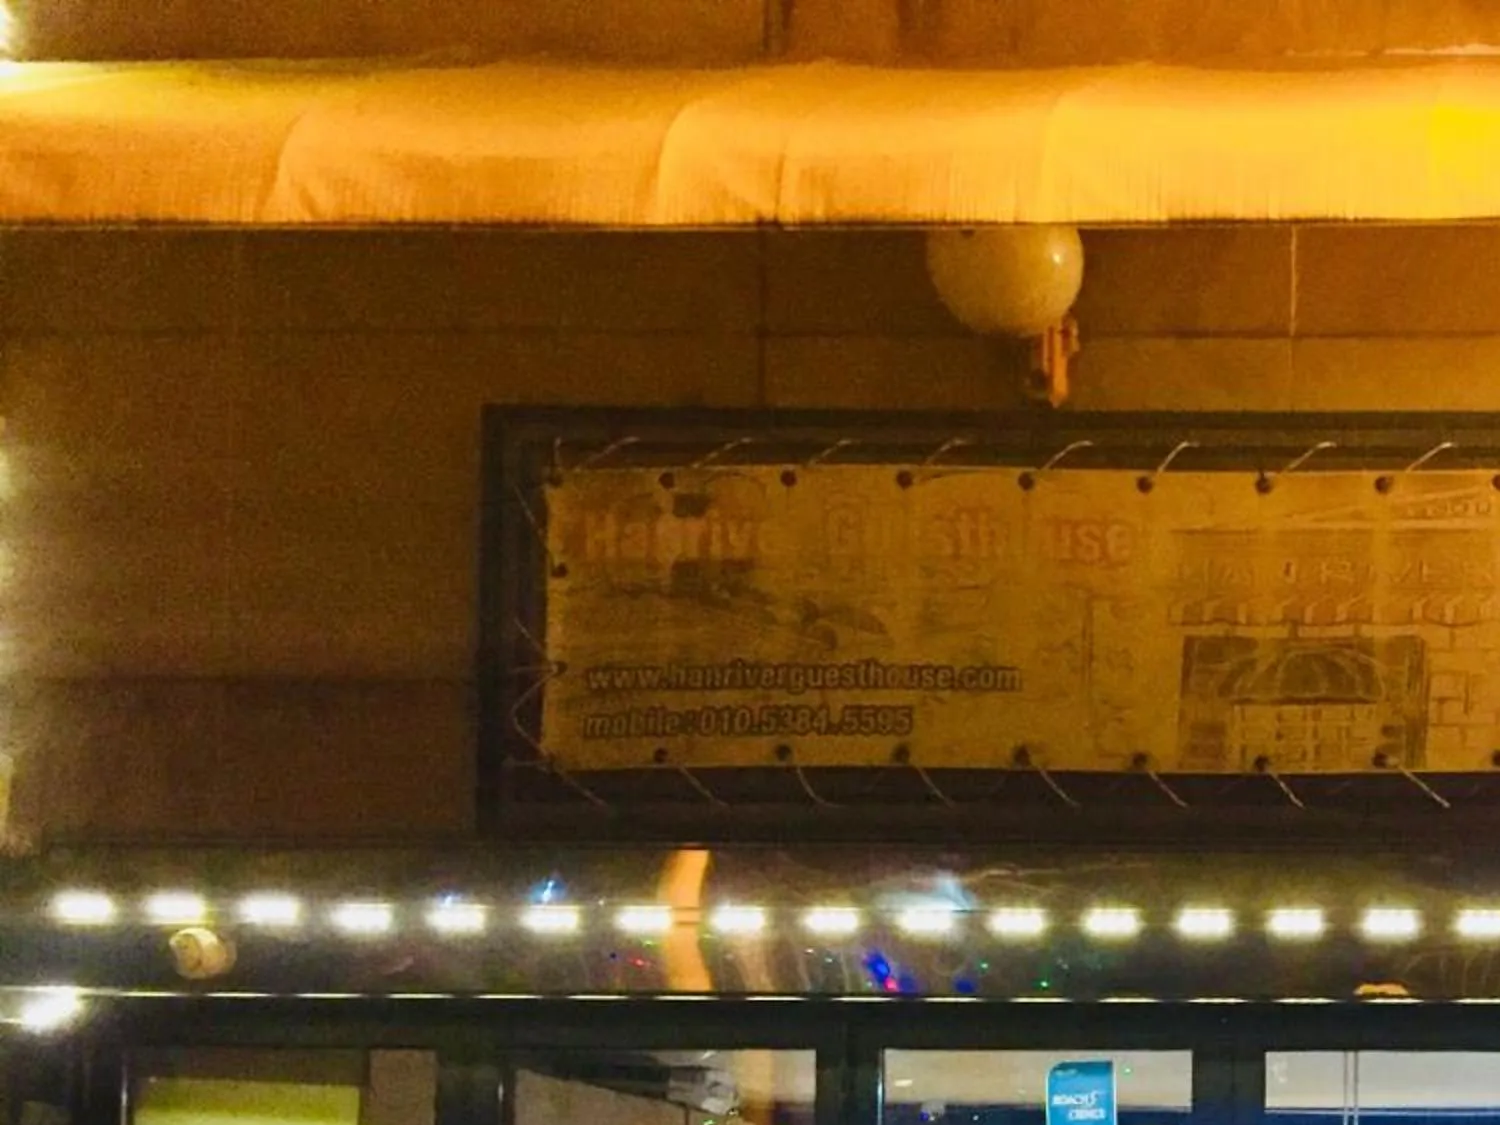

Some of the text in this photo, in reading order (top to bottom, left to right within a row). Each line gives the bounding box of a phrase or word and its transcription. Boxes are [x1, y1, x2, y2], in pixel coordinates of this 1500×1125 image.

[582, 508, 1137, 562] Harive Gusthuse
[586, 659, 1022, 695] www.hanriverguesthouse.com
